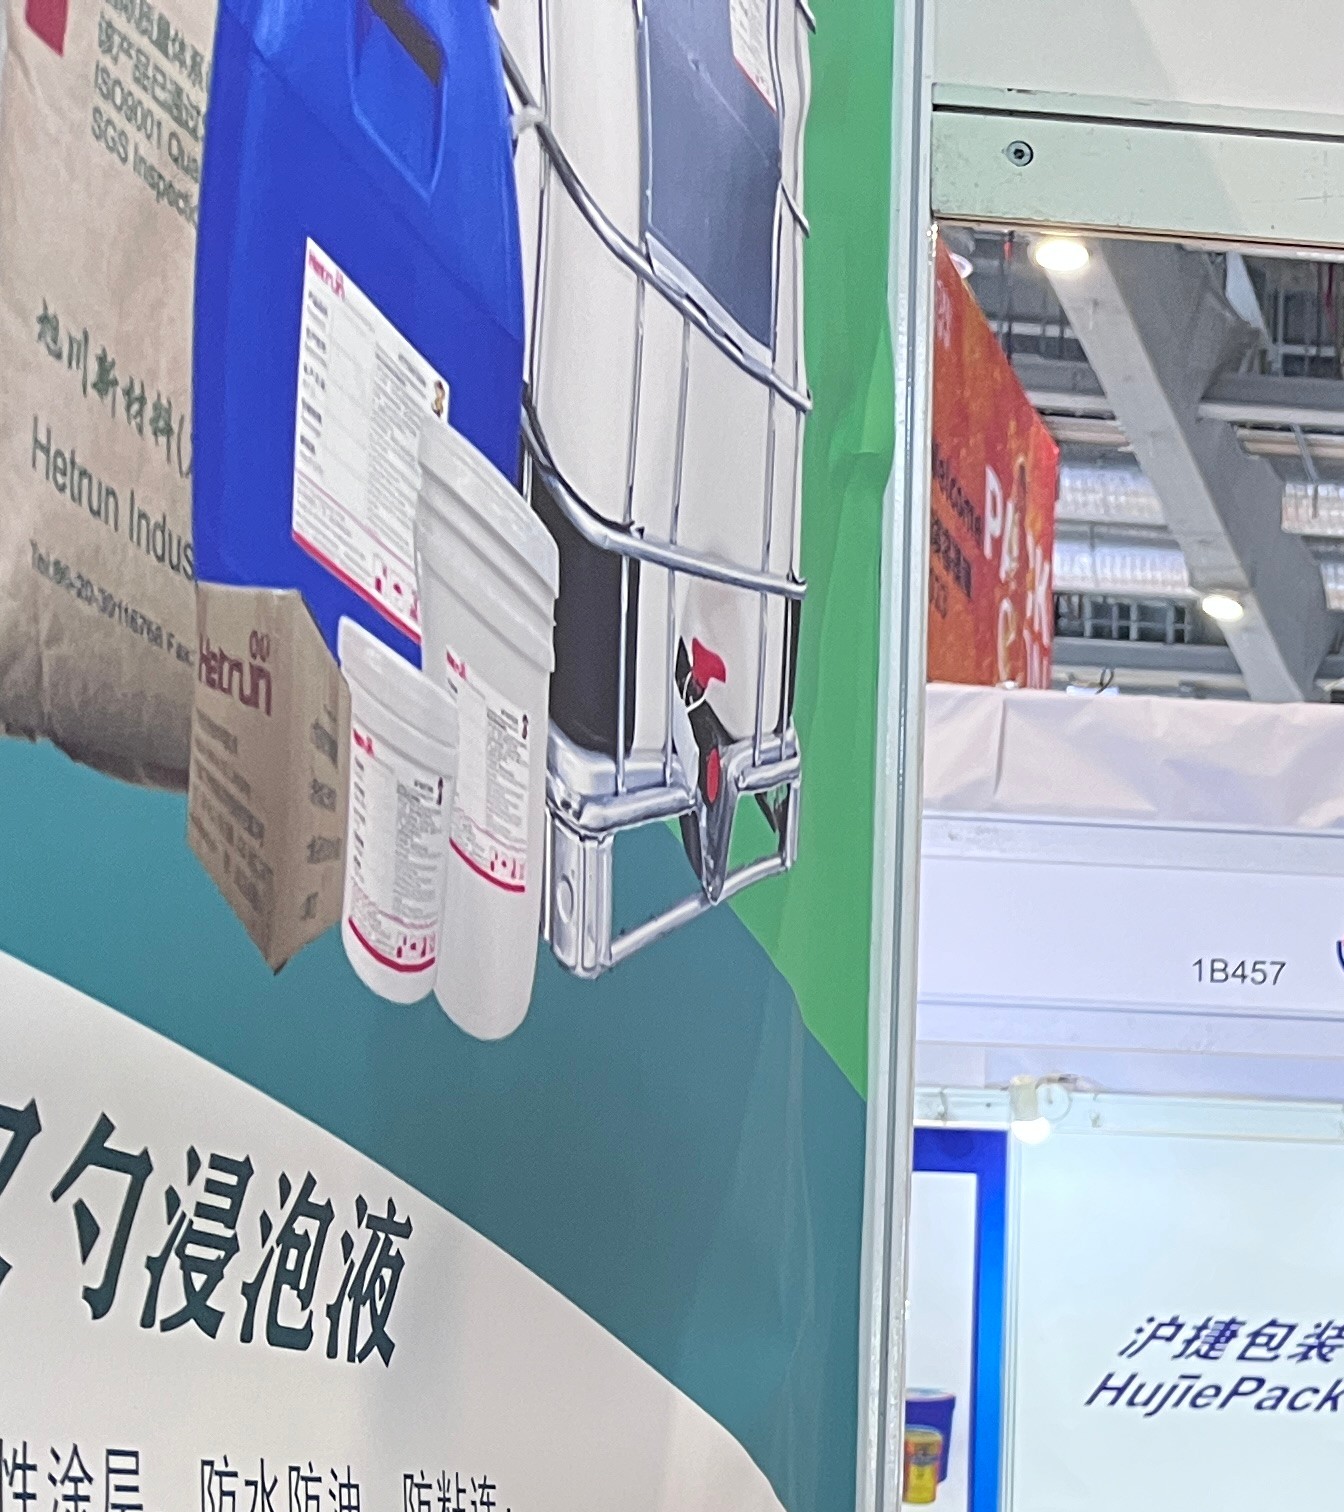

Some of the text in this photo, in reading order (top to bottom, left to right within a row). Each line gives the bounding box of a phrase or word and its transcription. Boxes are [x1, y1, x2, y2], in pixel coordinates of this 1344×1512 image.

[91, 106, 128, 166] SGS
[32, 414, 119, 532] Hetrun
[199, 632, 271, 717] Hetrun
[1192, 958, 1287, 986] 1B457
